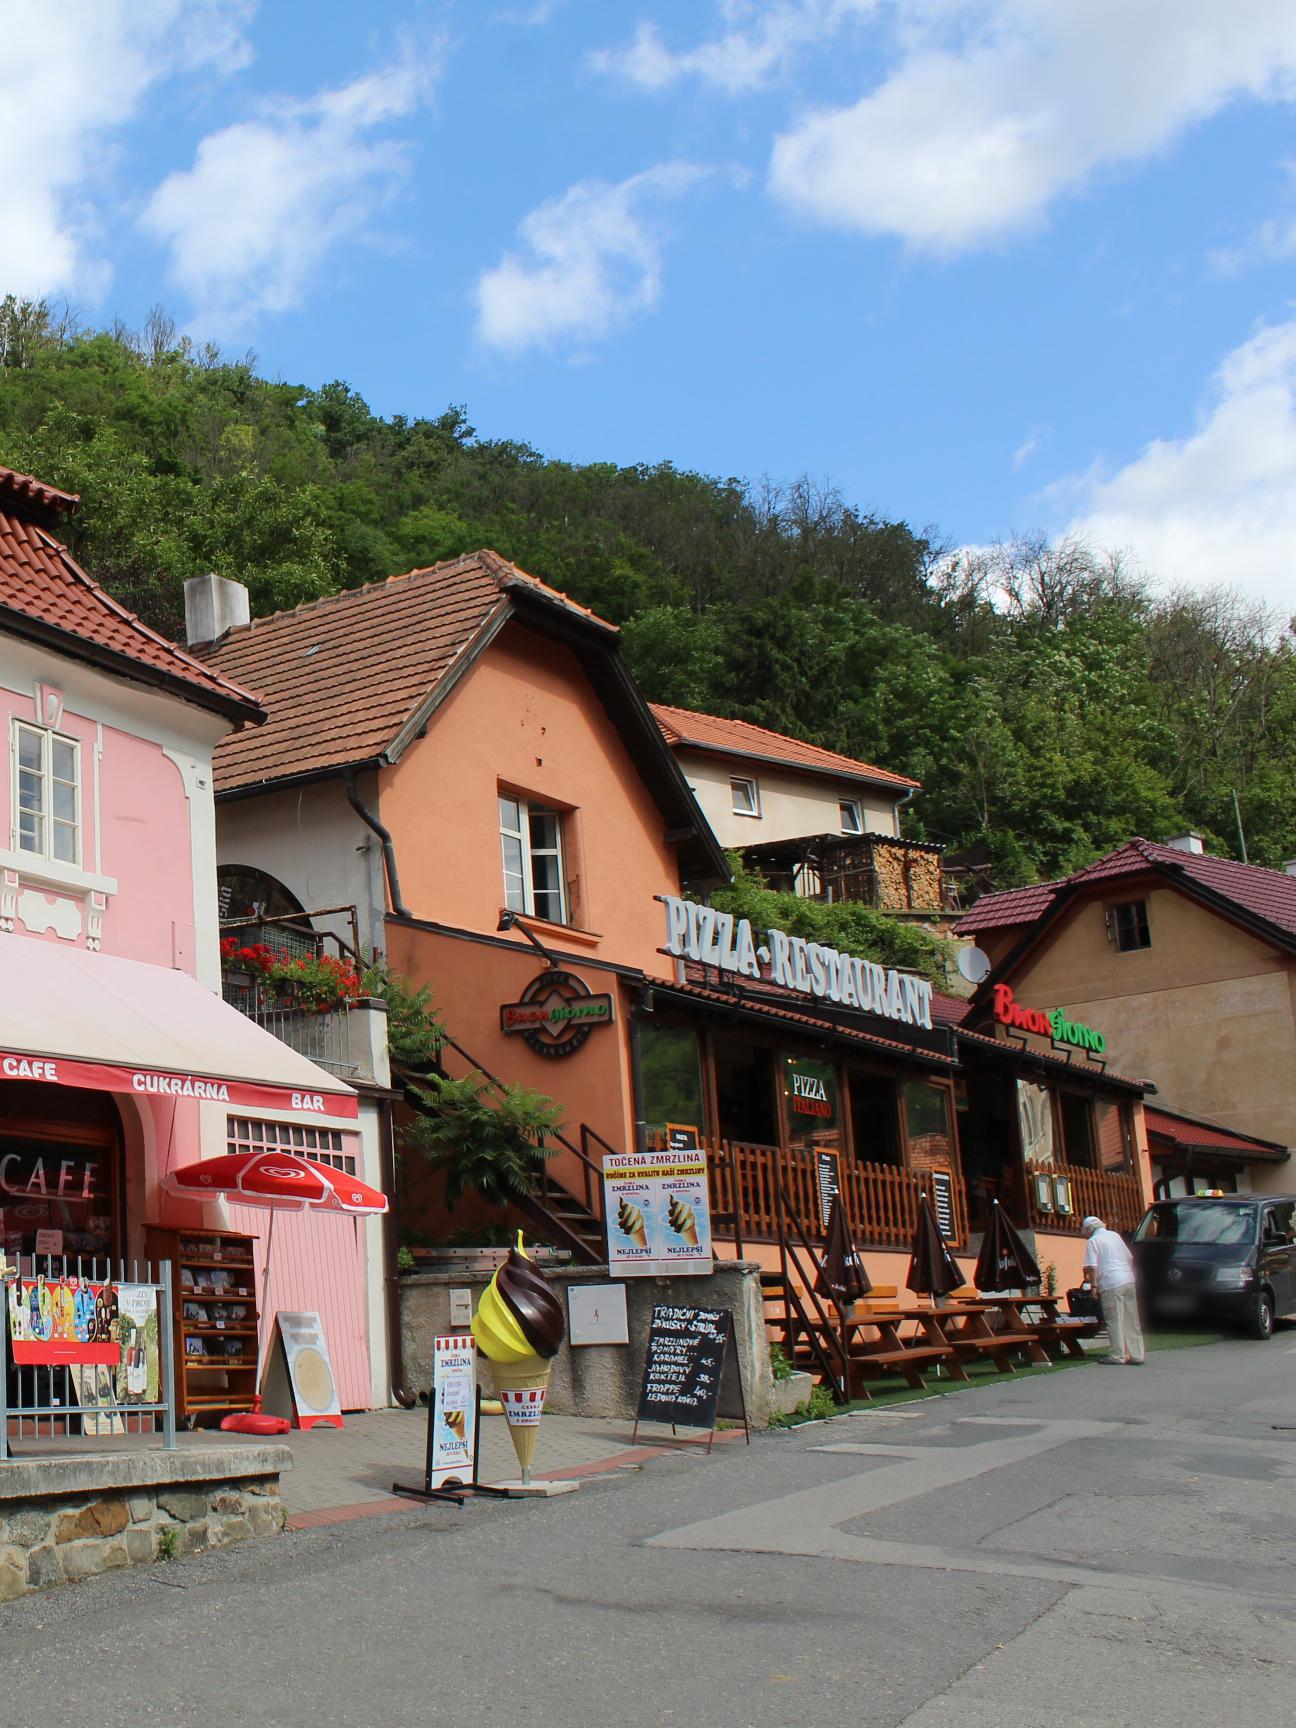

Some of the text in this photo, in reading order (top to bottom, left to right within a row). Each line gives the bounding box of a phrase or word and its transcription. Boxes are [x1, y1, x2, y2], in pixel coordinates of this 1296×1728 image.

[661, 895, 933, 1030] PIZZA RESTAURANT
[2, 1057, 325, 1111] CAFE CUKRÁRNA BAR
[792, 1074, 827, 1101] PIZZA
[609, 1153, 700, 1167] TOČENÁ ZMRZLINA
[611, 1184, 650, 1192] ZMRZLINA
[661, 1182, 701, 1190] ZMRZLINA
[651, 1336, 702, 1346] ZMRZLINOVÉ
[440, 1357, 471, 1368] ZMRZLINA
[652, 1354, 689, 1364] KARAMEL
[648, 1373, 687, 1382] KOKTEJL
